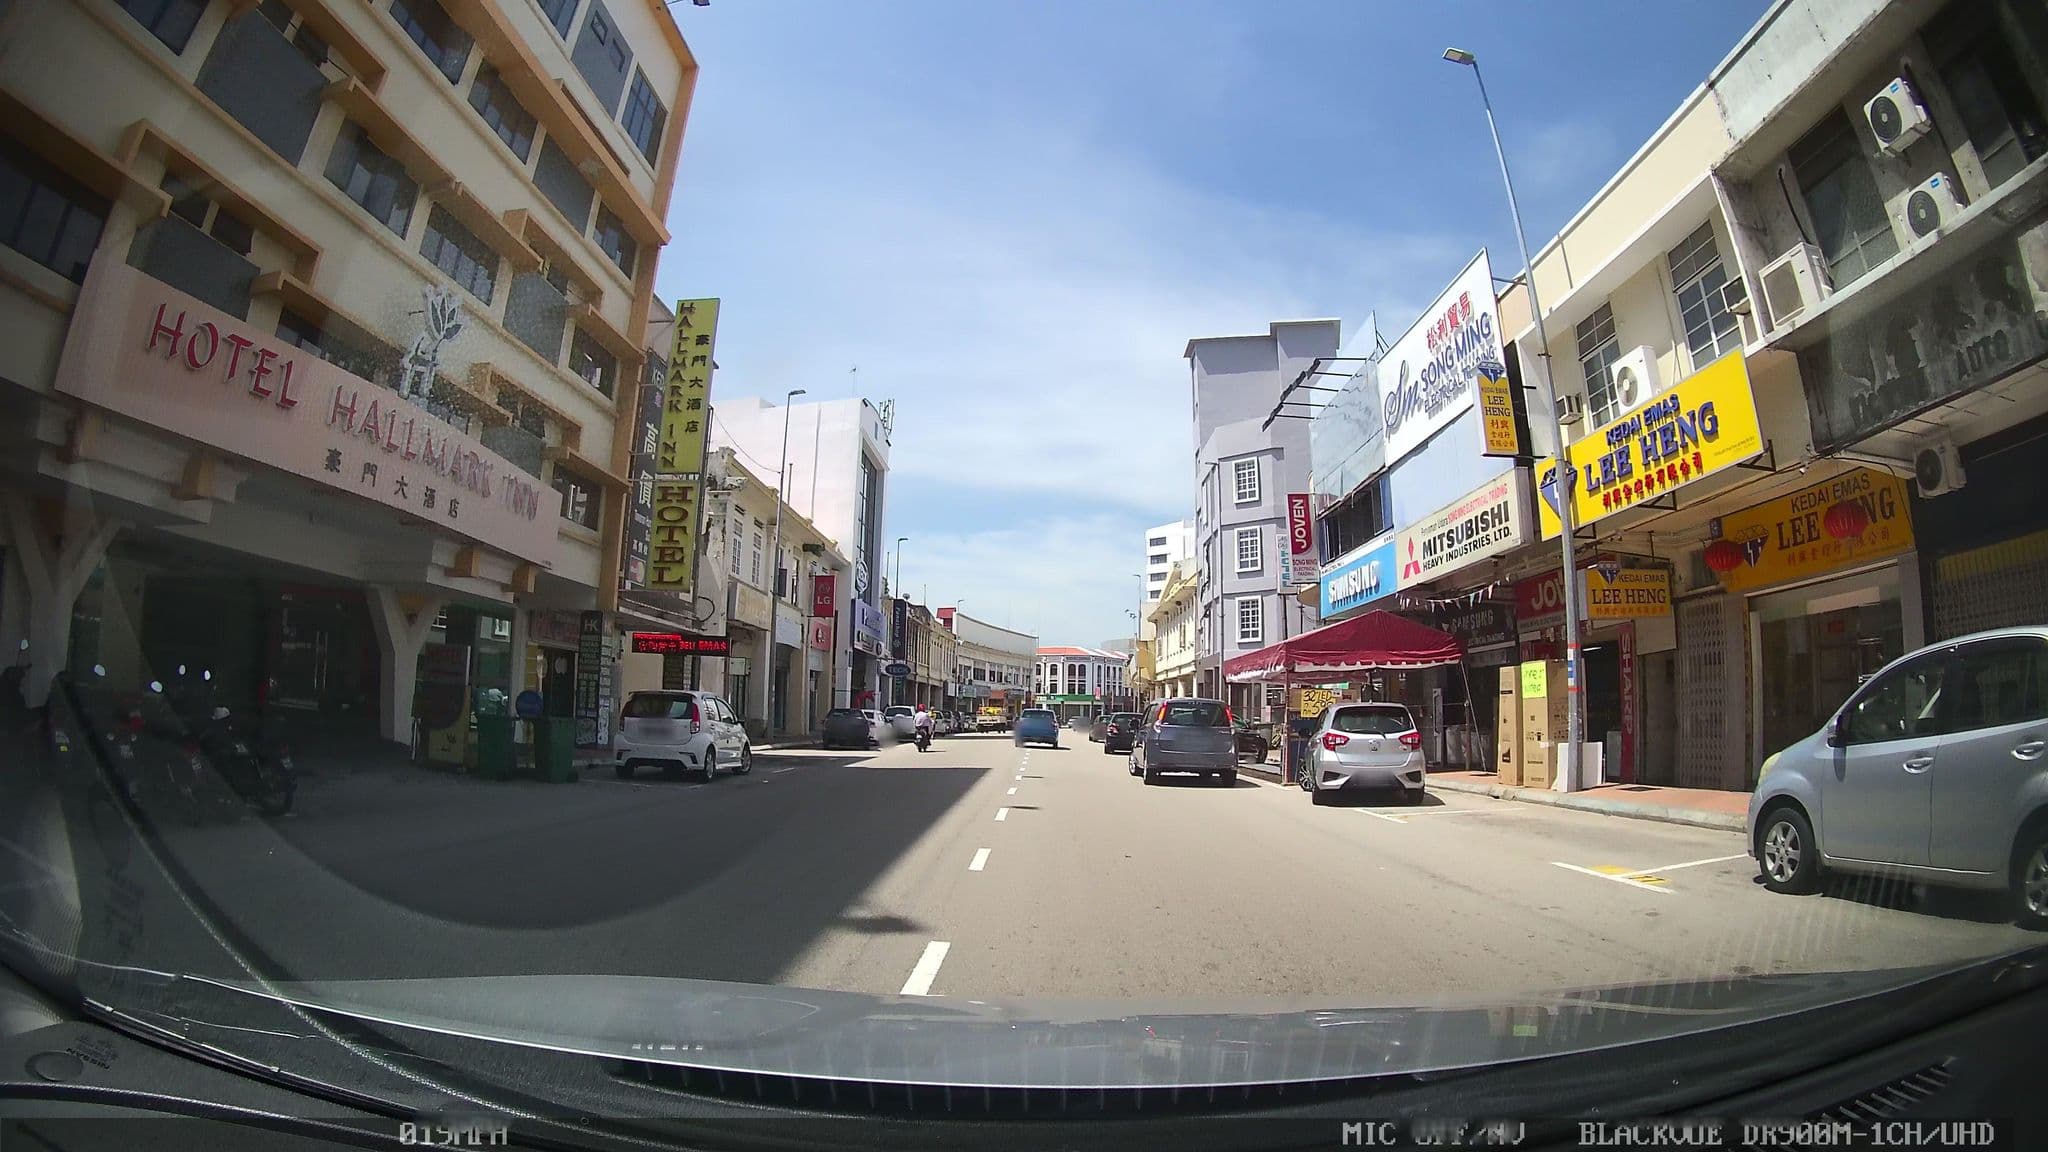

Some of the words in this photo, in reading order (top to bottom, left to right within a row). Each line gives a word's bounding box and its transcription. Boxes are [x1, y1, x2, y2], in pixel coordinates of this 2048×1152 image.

[669, 302, 696, 412] HALLMARK
[1421, 345, 1456, 392] SONG
[1454, 312, 1491, 360] MING
[146, 302, 298, 408] HOTEL
[328, 385, 493, 498] HALLMARK
[684, 334, 710, 433] 豪門大酒店
[1424, 372, 1463, 413] ELECTRICAL
[1461, 345, 1496, 382] TRDING
[1487, 396, 1505, 405] LEE
[1484, 406, 1511, 417] HENG
[1606, 414, 1642, 445] KEDAI
[1643, 394, 1679, 426] EMAS
[661, 423, 678, 467] INN
[1584, 445, 1633, 492] LEE
[1639, 401, 1719, 466] HENG
[324, 448, 461, 518] 豪門大酒店
[1791, 487, 1829, 513] KEDAI
[1833, 473, 1870, 499] EMAS
[652, 486, 694, 584] HOTEL
[1292, 499, 1307, 549] JOVEN
[1422, 500, 1510, 560] MITSUBISHI
[1422, 556, 1444, 572] HEAVY
[1445, 534, 1493, 563] INDUSTRIES,
[1493, 526, 1512, 543] LTD.
[1776, 511, 1820, 550] LEE
[817, 596, 831, 605] LG
[1329, 560, 1380, 605] SAMSUNG
[1531, 573, 1566, 610] JOV
[1591, 588, 1621, 605] LEE
[1624, 588, 1666, 604] HENG
[1619, 574, 1643, 583] KEDAI
[1644, 573, 1665, 582] EMAS
[1622, 632, 1632, 735] SHARP
